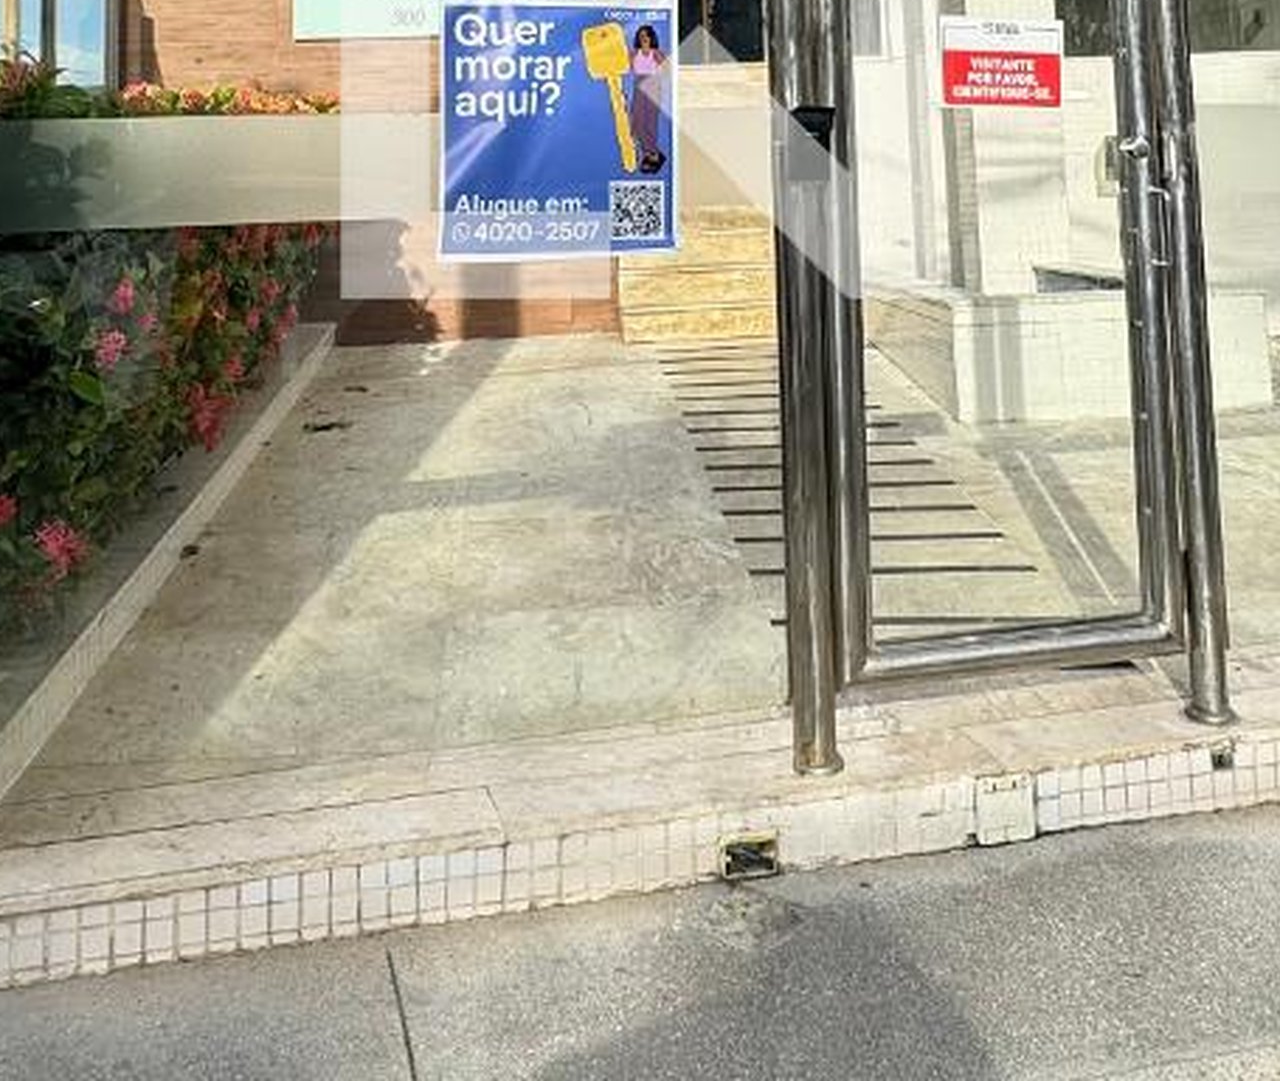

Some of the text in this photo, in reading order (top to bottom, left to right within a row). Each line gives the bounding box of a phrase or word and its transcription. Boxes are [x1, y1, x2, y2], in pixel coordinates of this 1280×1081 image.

[454, 13, 555, 46] Quer
[454, 55, 572, 81] morar
[454, 81, 561, 122] aqui?
[453, 193, 590, 221] Alugue em:
